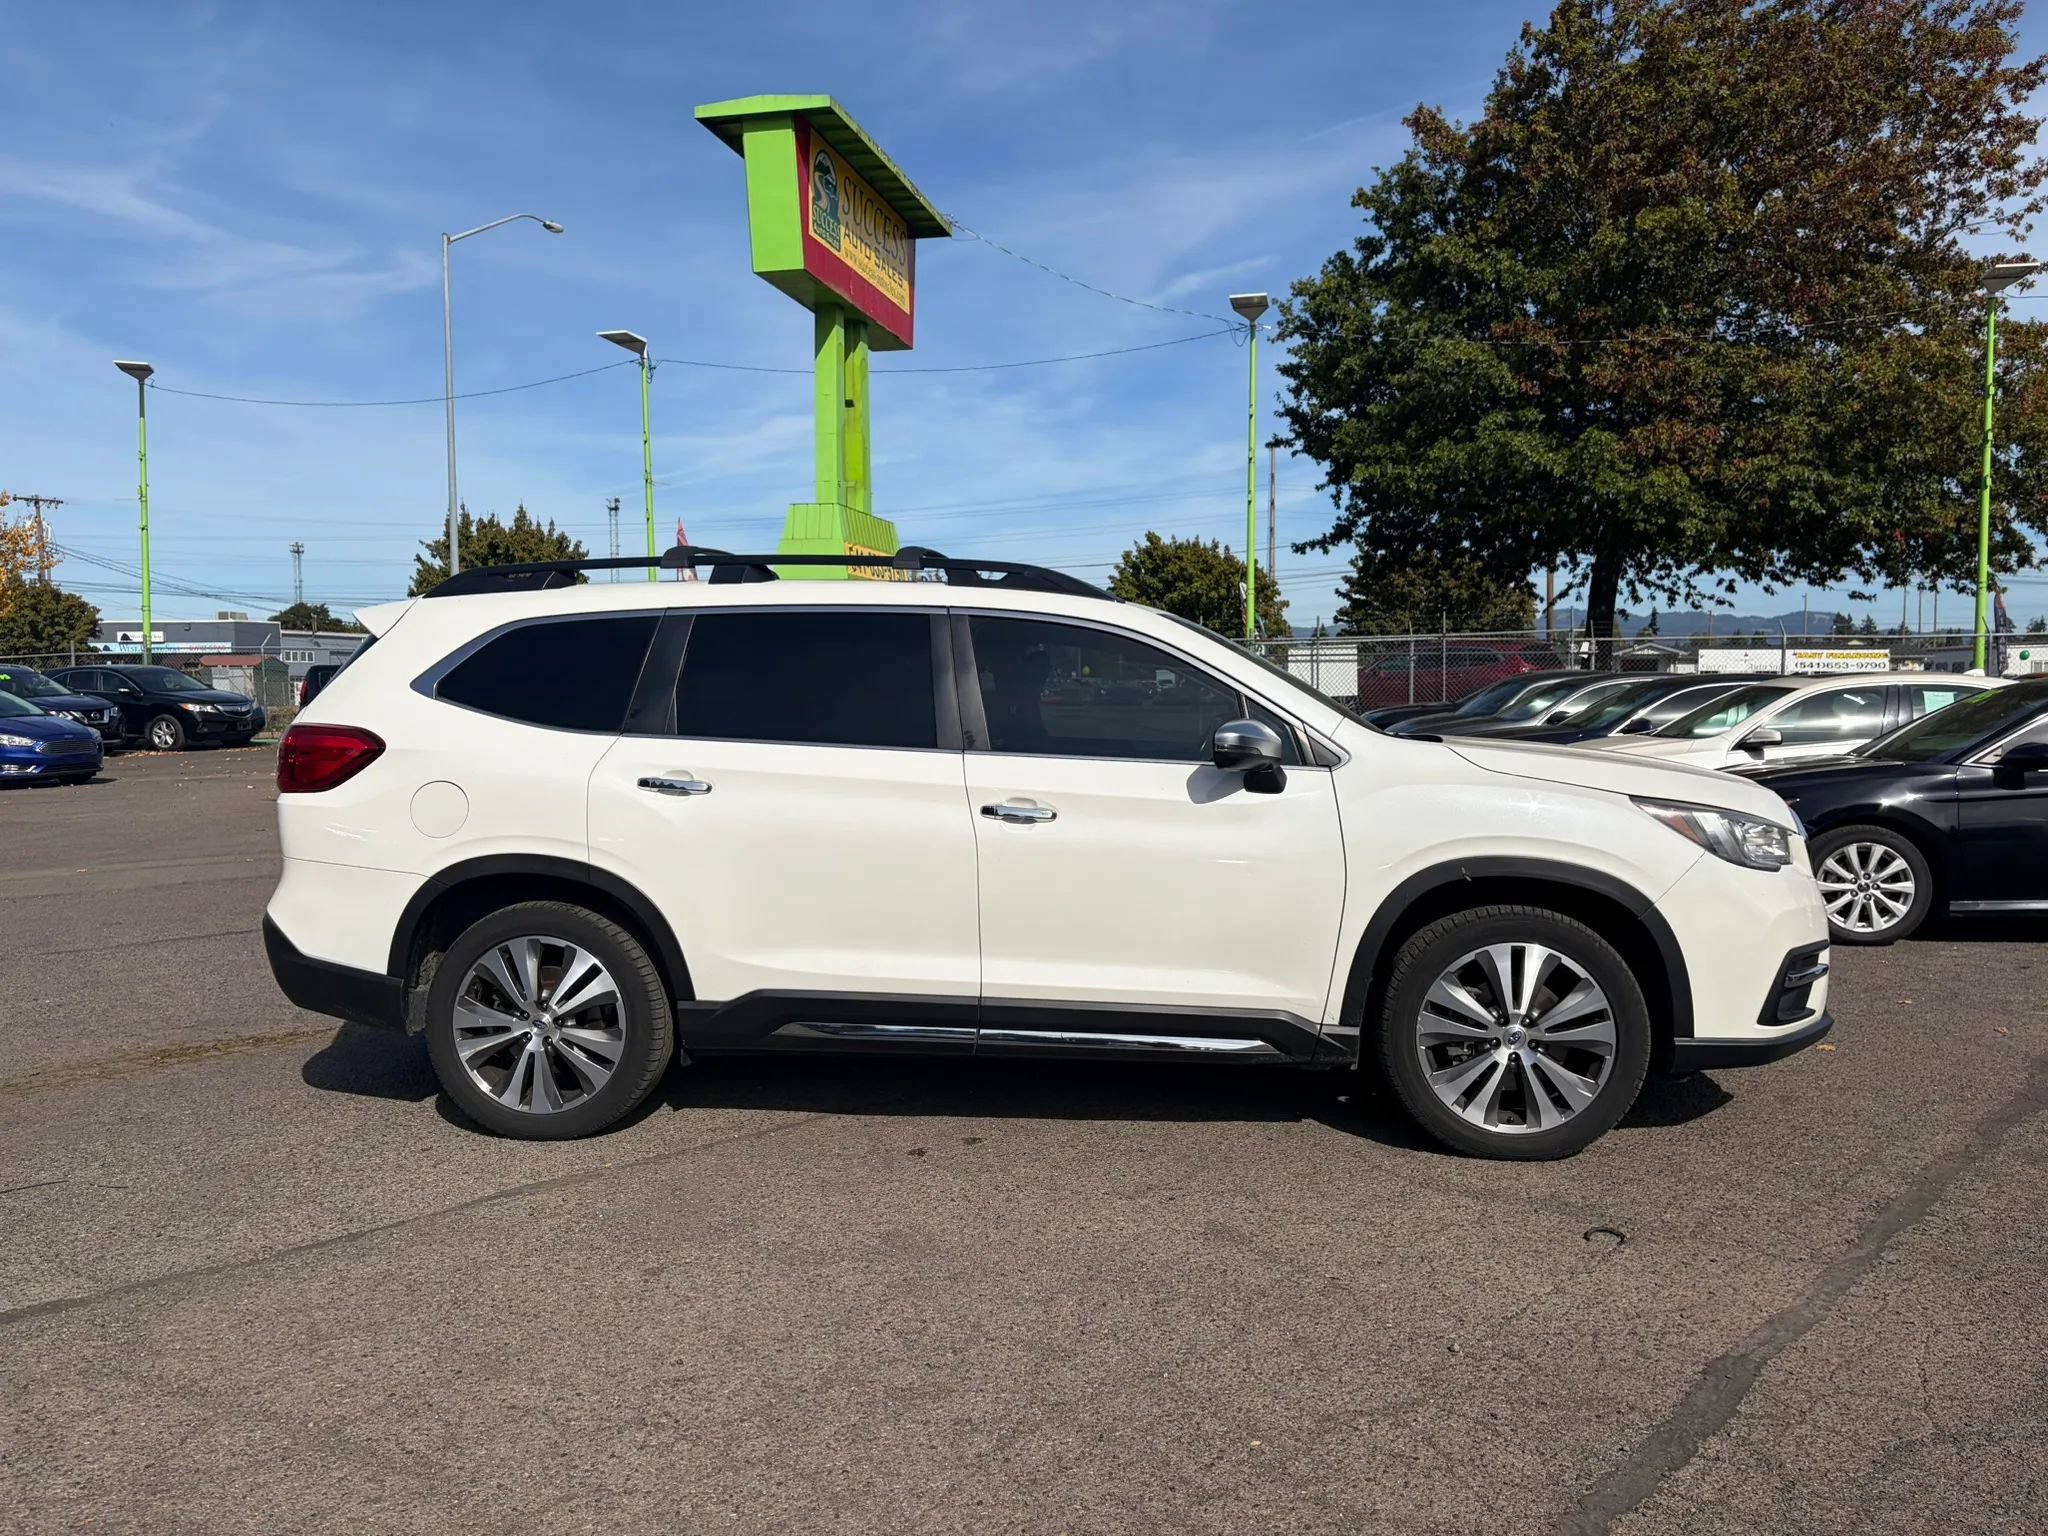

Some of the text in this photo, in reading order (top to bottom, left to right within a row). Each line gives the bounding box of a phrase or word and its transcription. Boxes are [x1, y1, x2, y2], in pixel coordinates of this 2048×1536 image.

[813, 205, 840, 240] SUCCESS
[842, 175, 907, 266] SUCCESS
[843, 221, 903, 289] AUTO SALES
[1795, 660, 1886, 670] (541)653-9790
